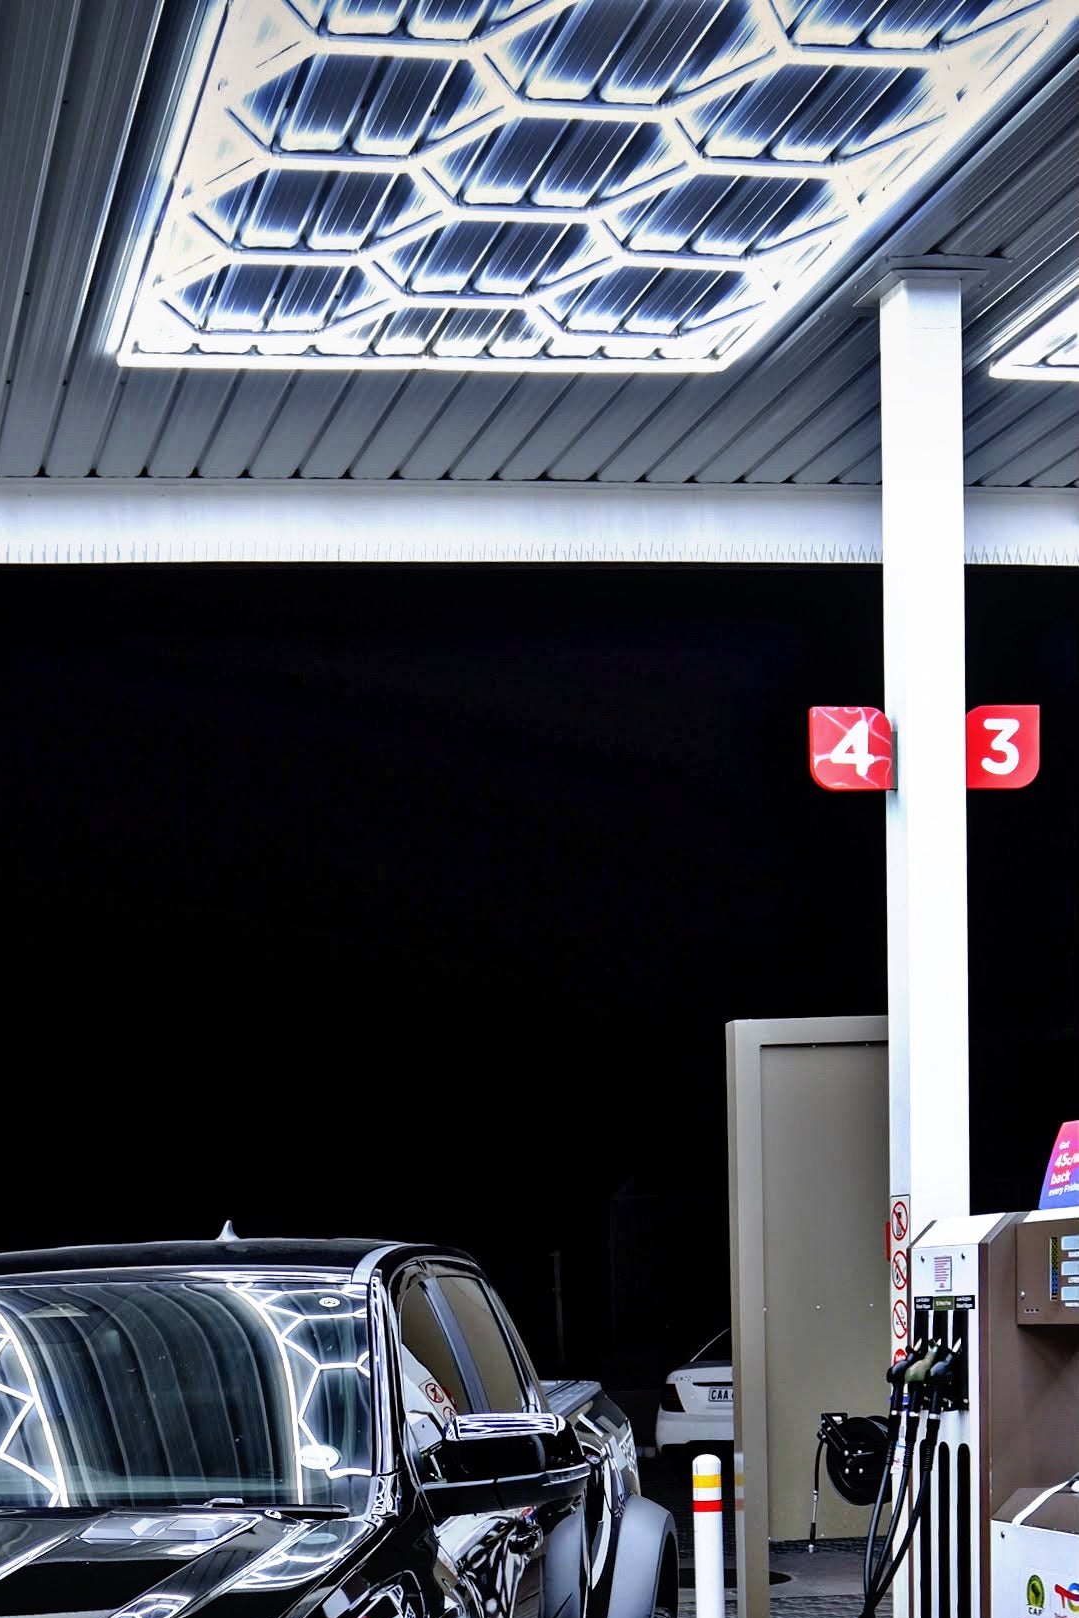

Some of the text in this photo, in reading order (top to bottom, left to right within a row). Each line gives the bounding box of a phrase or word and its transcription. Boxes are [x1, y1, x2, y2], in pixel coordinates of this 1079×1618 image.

[829, 719, 875, 777] 4
[980, 718, 1020, 776] 3
[1050, 1170, 1072, 1186] back
[711, 1390, 729, 1400] CAA
